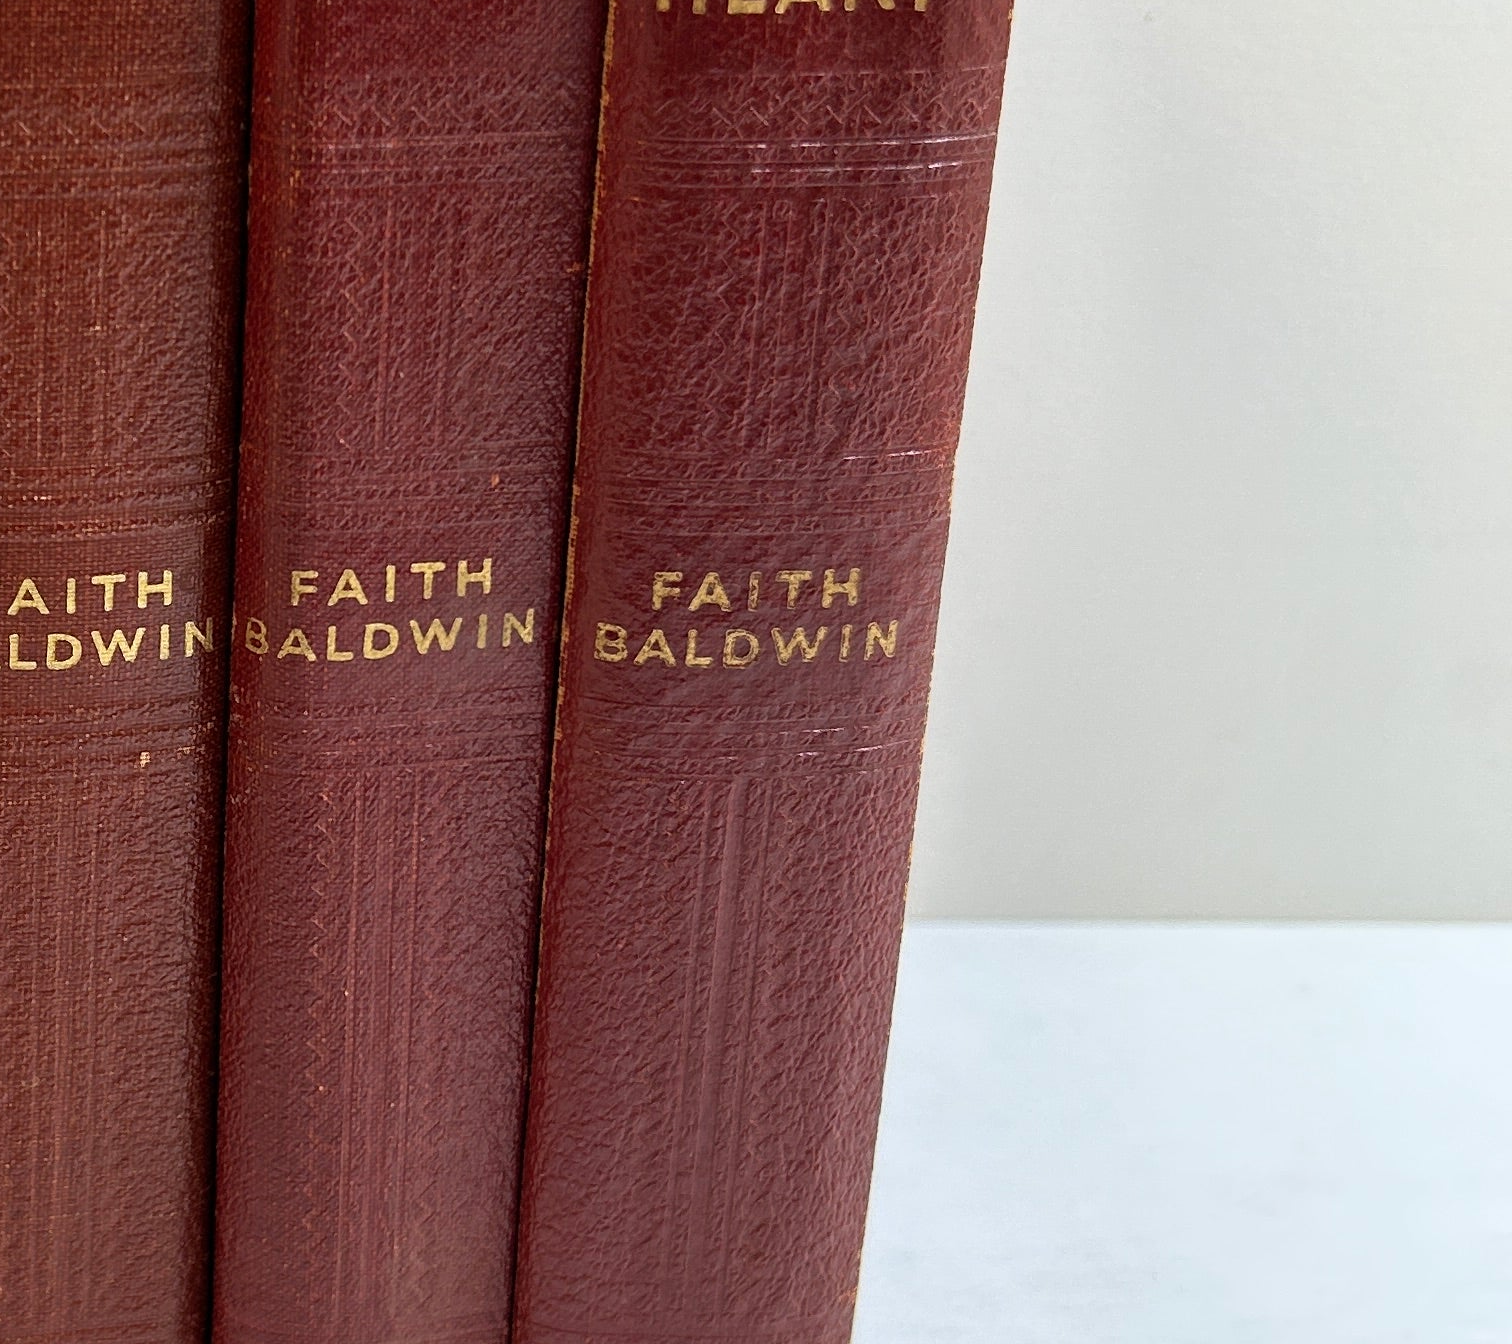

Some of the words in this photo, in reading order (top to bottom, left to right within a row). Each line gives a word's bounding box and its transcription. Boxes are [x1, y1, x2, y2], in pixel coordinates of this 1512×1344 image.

[289, 557, 493, 608] FAITH
[651, 566, 863, 613] FAITH
[245, 608, 537, 662] BALDWIN
[593, 619, 901, 669] BALDWIN
